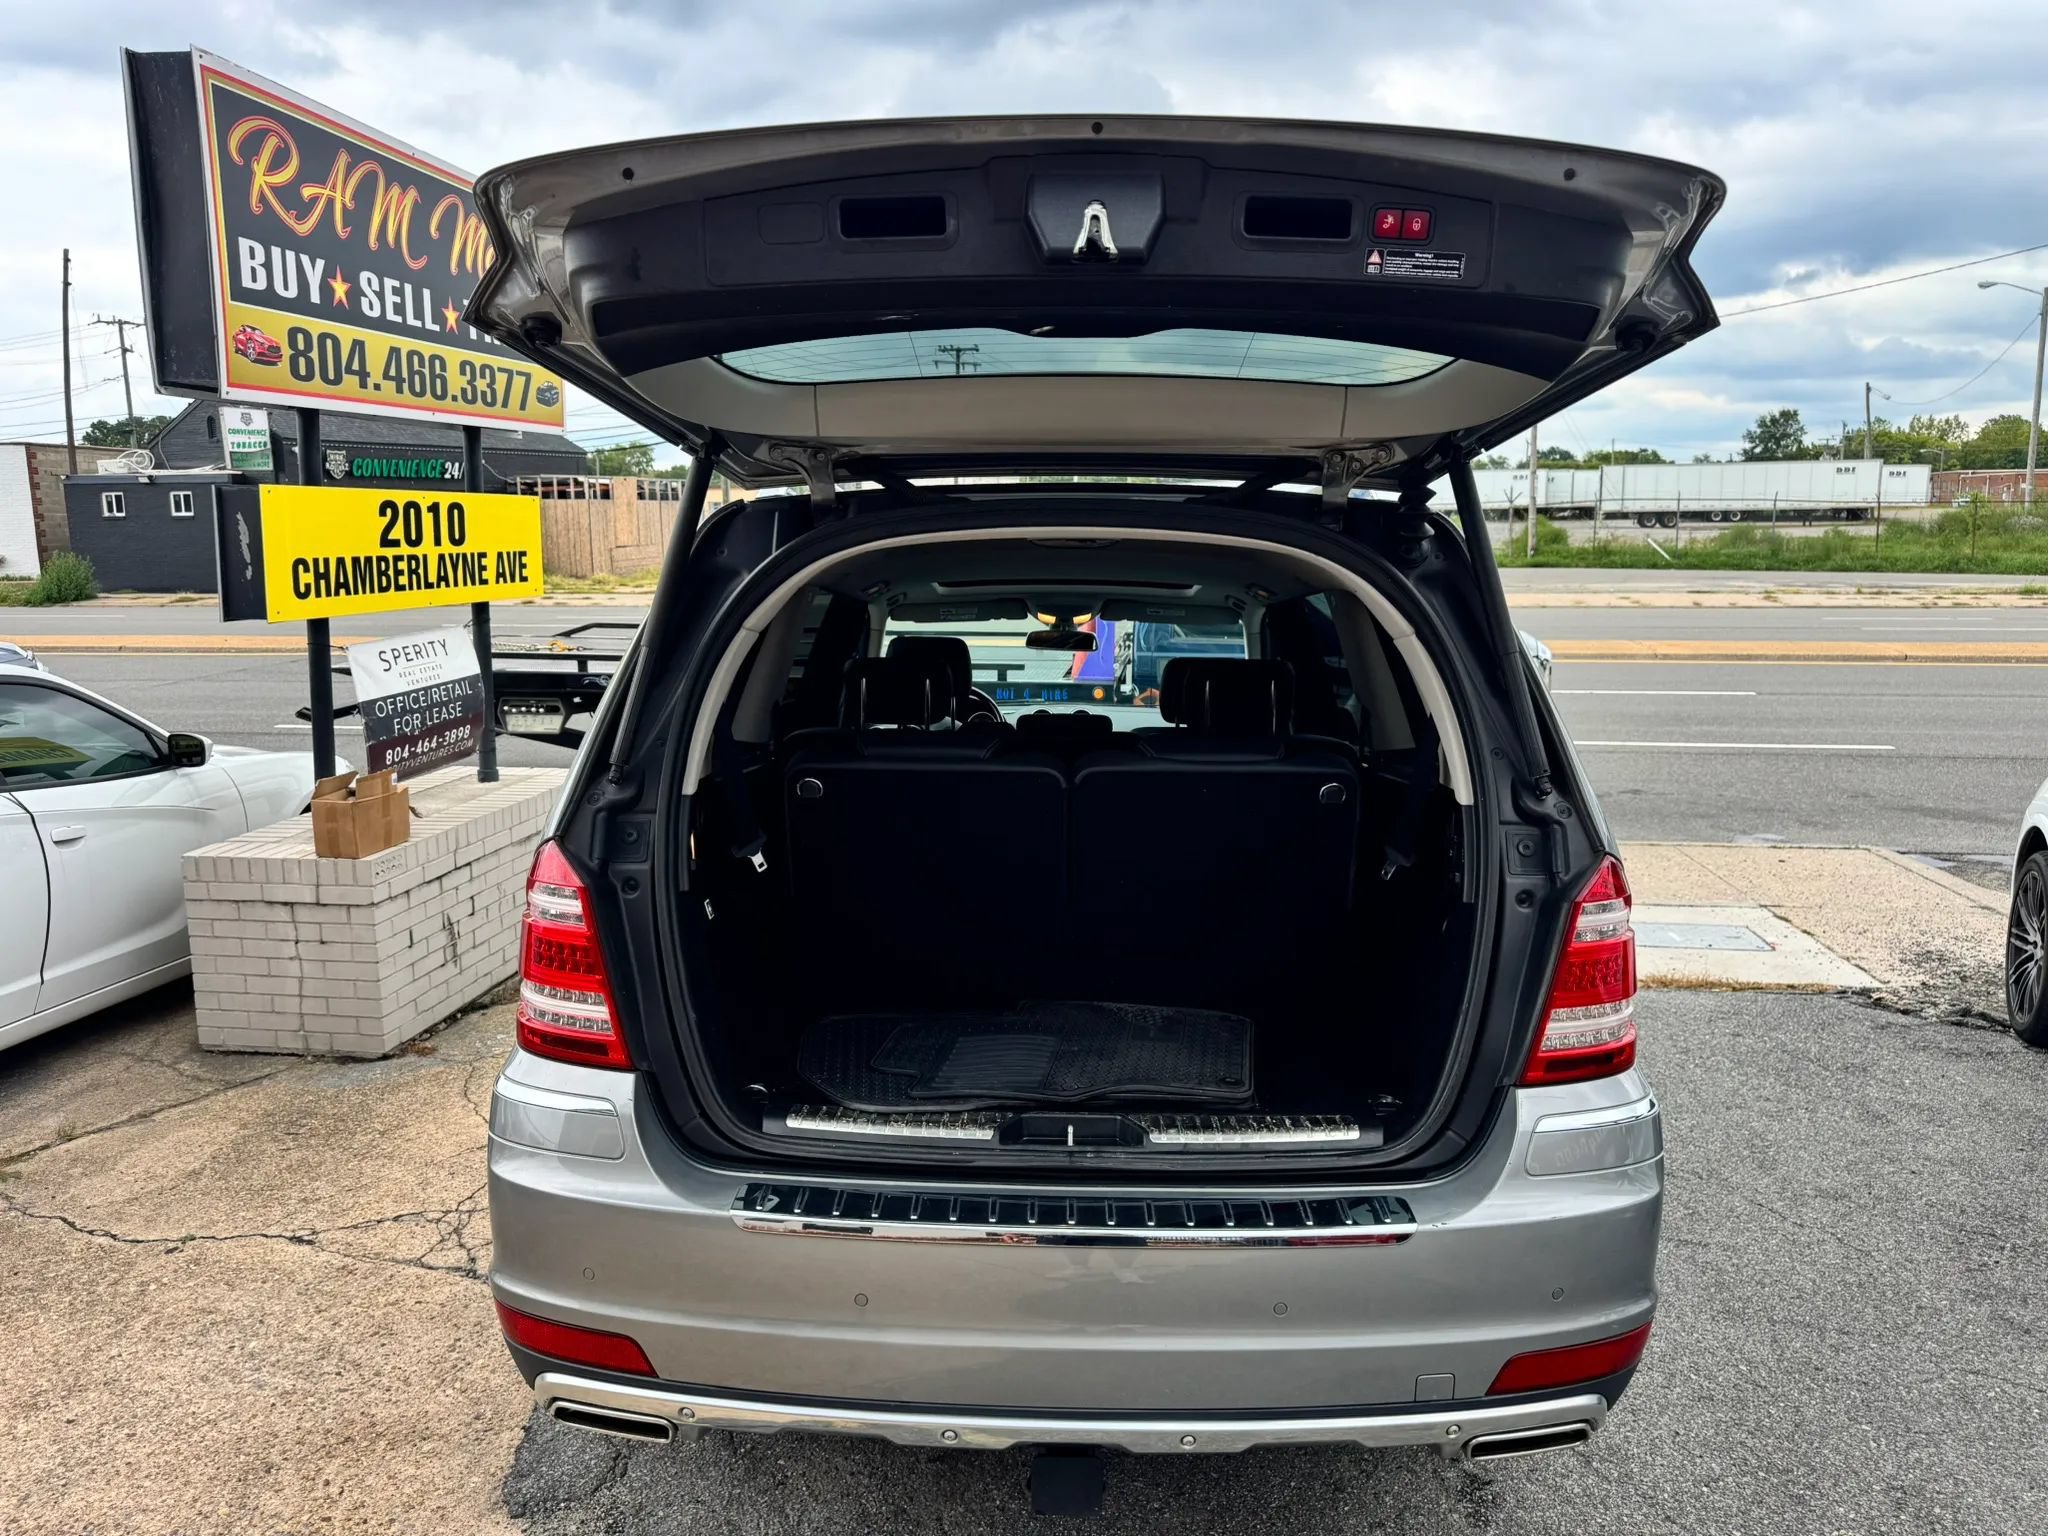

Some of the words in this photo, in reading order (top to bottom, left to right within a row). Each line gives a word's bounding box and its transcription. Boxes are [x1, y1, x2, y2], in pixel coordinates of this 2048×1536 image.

[228, 115, 428, 270] RAM
[238, 236, 326, 304] BUY
[359, 270, 440, 332] SELL
[287, 326, 532, 412] 804.466.3377
[228, 428, 267, 437] CONVENIENCE
[230, 441, 268, 449] TOBACCO
[352, 458, 445, 478] CONVENIENCE
[444, 461, 465, 479] 24/
[378, 499, 467, 549] 2010
[291, 552, 489, 600] CHAMBERLAYNE
[495, 551, 529, 585] AVE
[378, 638, 449, 672] SPERITY
[375, 679, 473, 717] OFFICE/RETAIL
[393, 713, 422, 737] FOR
[426, 701, 463, 725] LEASE
[385, 724, 471, 765] 804-464-3898
